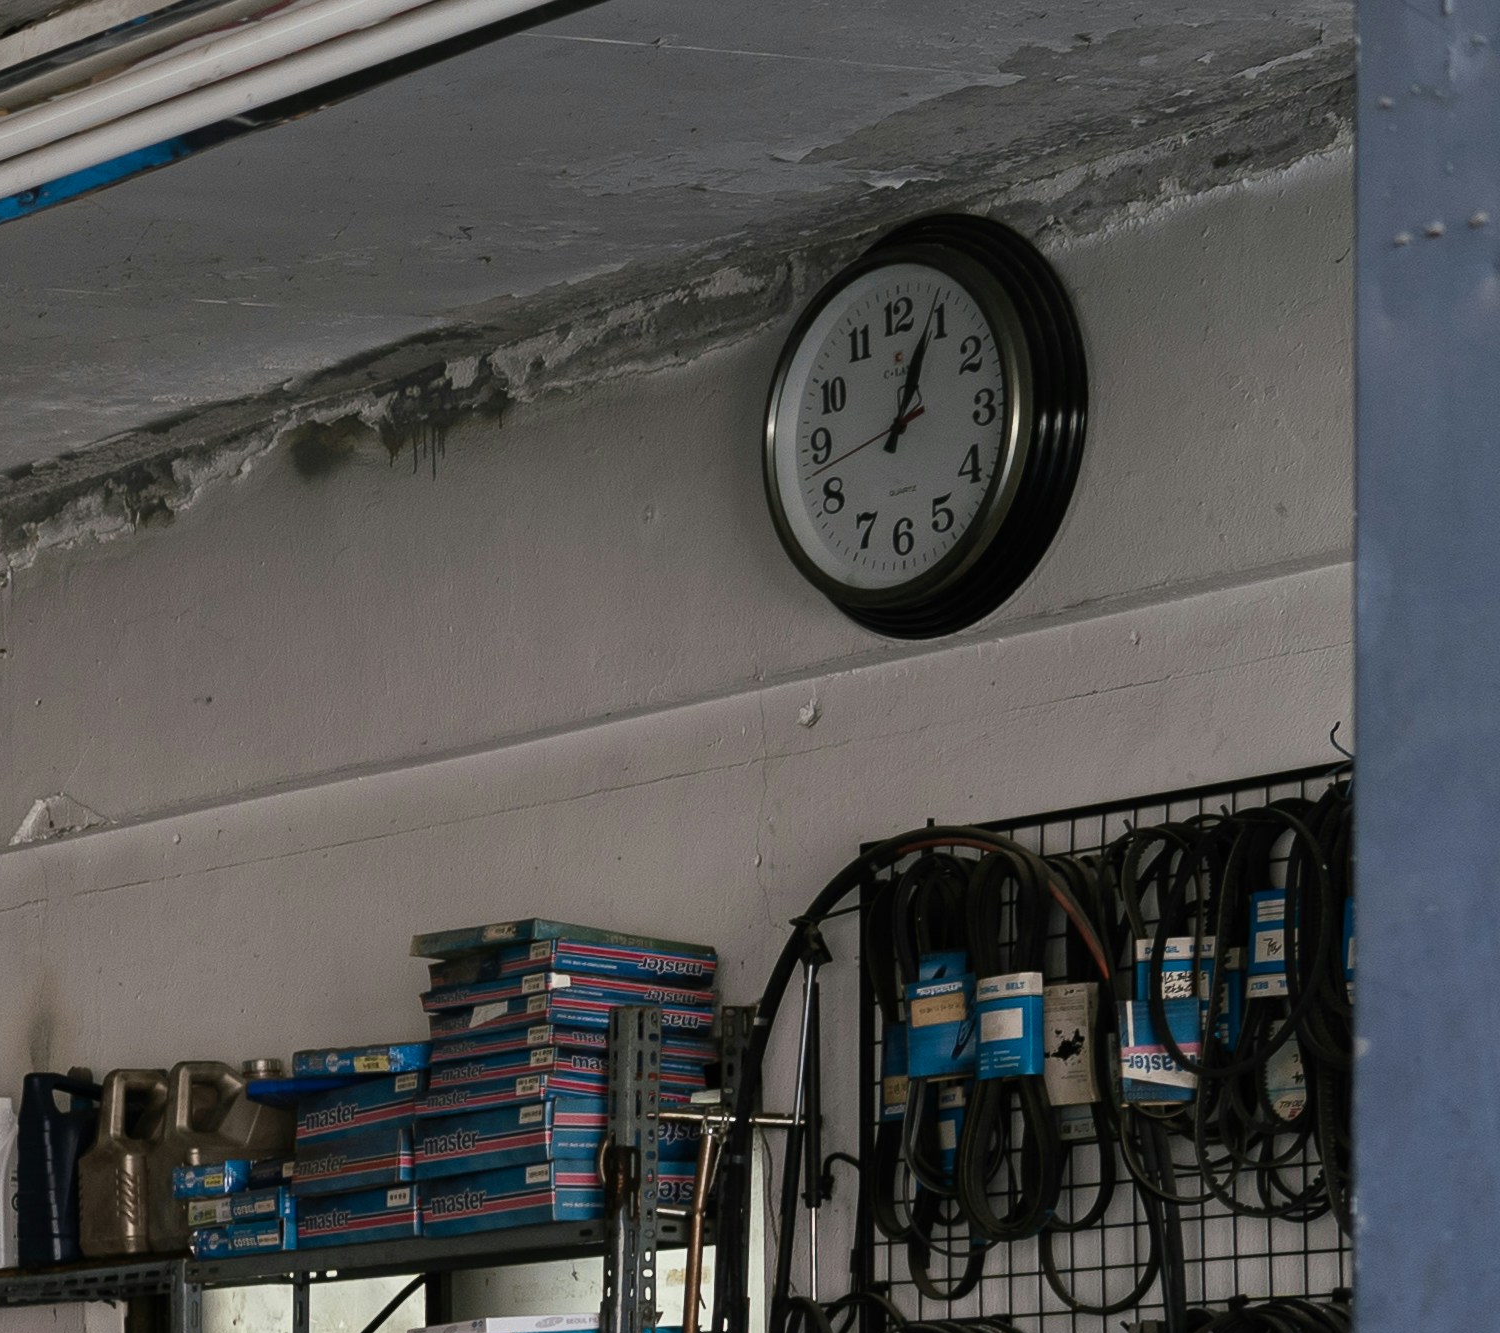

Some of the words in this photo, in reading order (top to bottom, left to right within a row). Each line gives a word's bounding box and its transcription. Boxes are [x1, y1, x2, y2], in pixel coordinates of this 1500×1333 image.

[884, 297, 913, 337] 12
[934, 303, 947, 340] 1
[848, 324, 872, 363] 11
[958, 335, 982, 375] 2
[821, 376, 846, 415] 10
[973, 388, 997, 426] 3
[811, 428, 832, 464] 9
[958, 444, 982, 484] 4
[822, 477, 845, 514] 8
[931, 492, 955, 533] 5
[856, 511, 878, 549] 7
[892, 518, 914, 556] 6
[637, 956, 704, 977] master
[660, 1010, 700, 1029] mas
[571, 1032, 609, 1045] mas
[440, 1064, 485, 1082] master
[571, 1054, 610, 1071] mas
[304, 1103, 359, 1131] master
[424, 1130, 479, 1156] master
[298, 1155, 346, 1177] master
[304, 1208, 352, 1232] master
[431, 1190, 486, 1215] master
